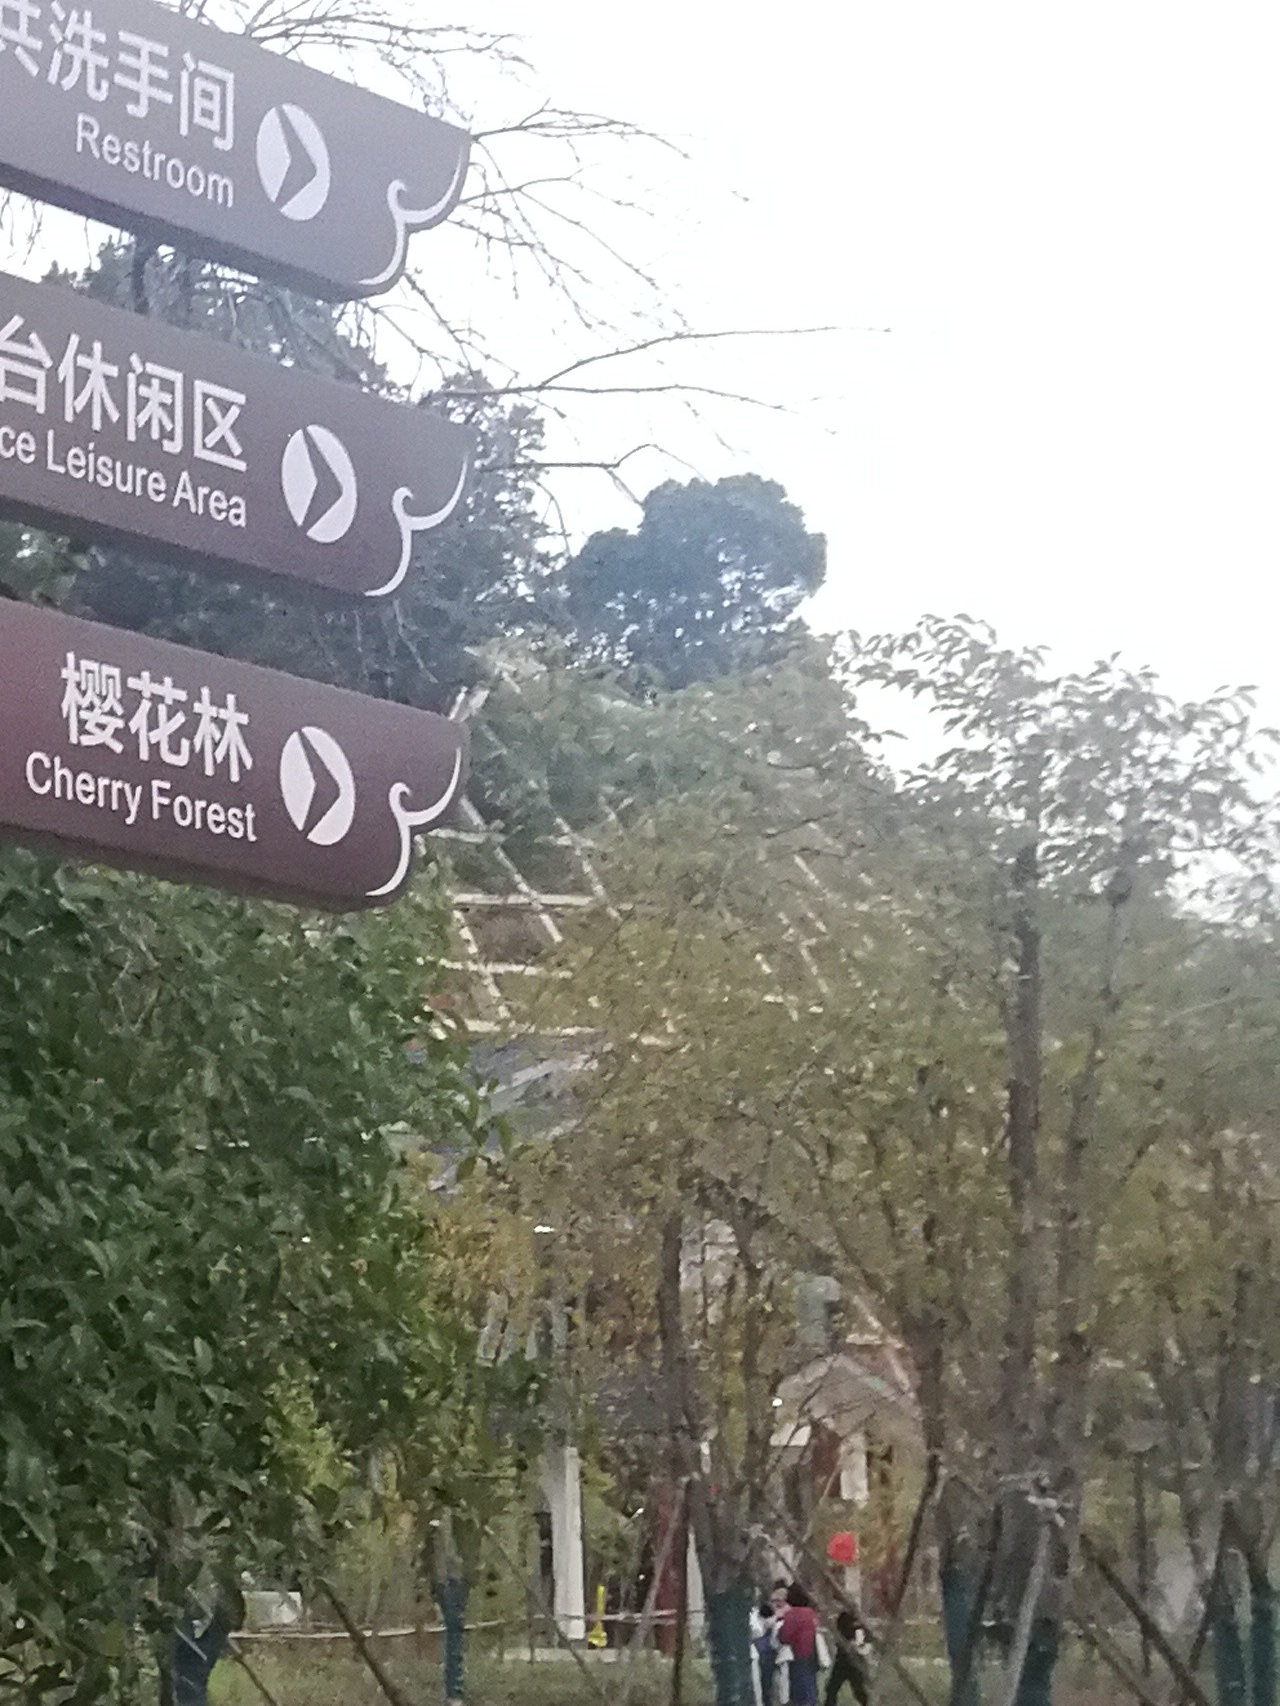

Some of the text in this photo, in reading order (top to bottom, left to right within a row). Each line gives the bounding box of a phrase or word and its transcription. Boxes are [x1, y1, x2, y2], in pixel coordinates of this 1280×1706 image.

[75, 112, 235, 209] Restroom
[45, 429, 167, 502] Leisure
[173, 470, 247, 528] Area
[60, 650, 253, 784] 樱花林
[25, 750, 258, 844] Cherry Forest
